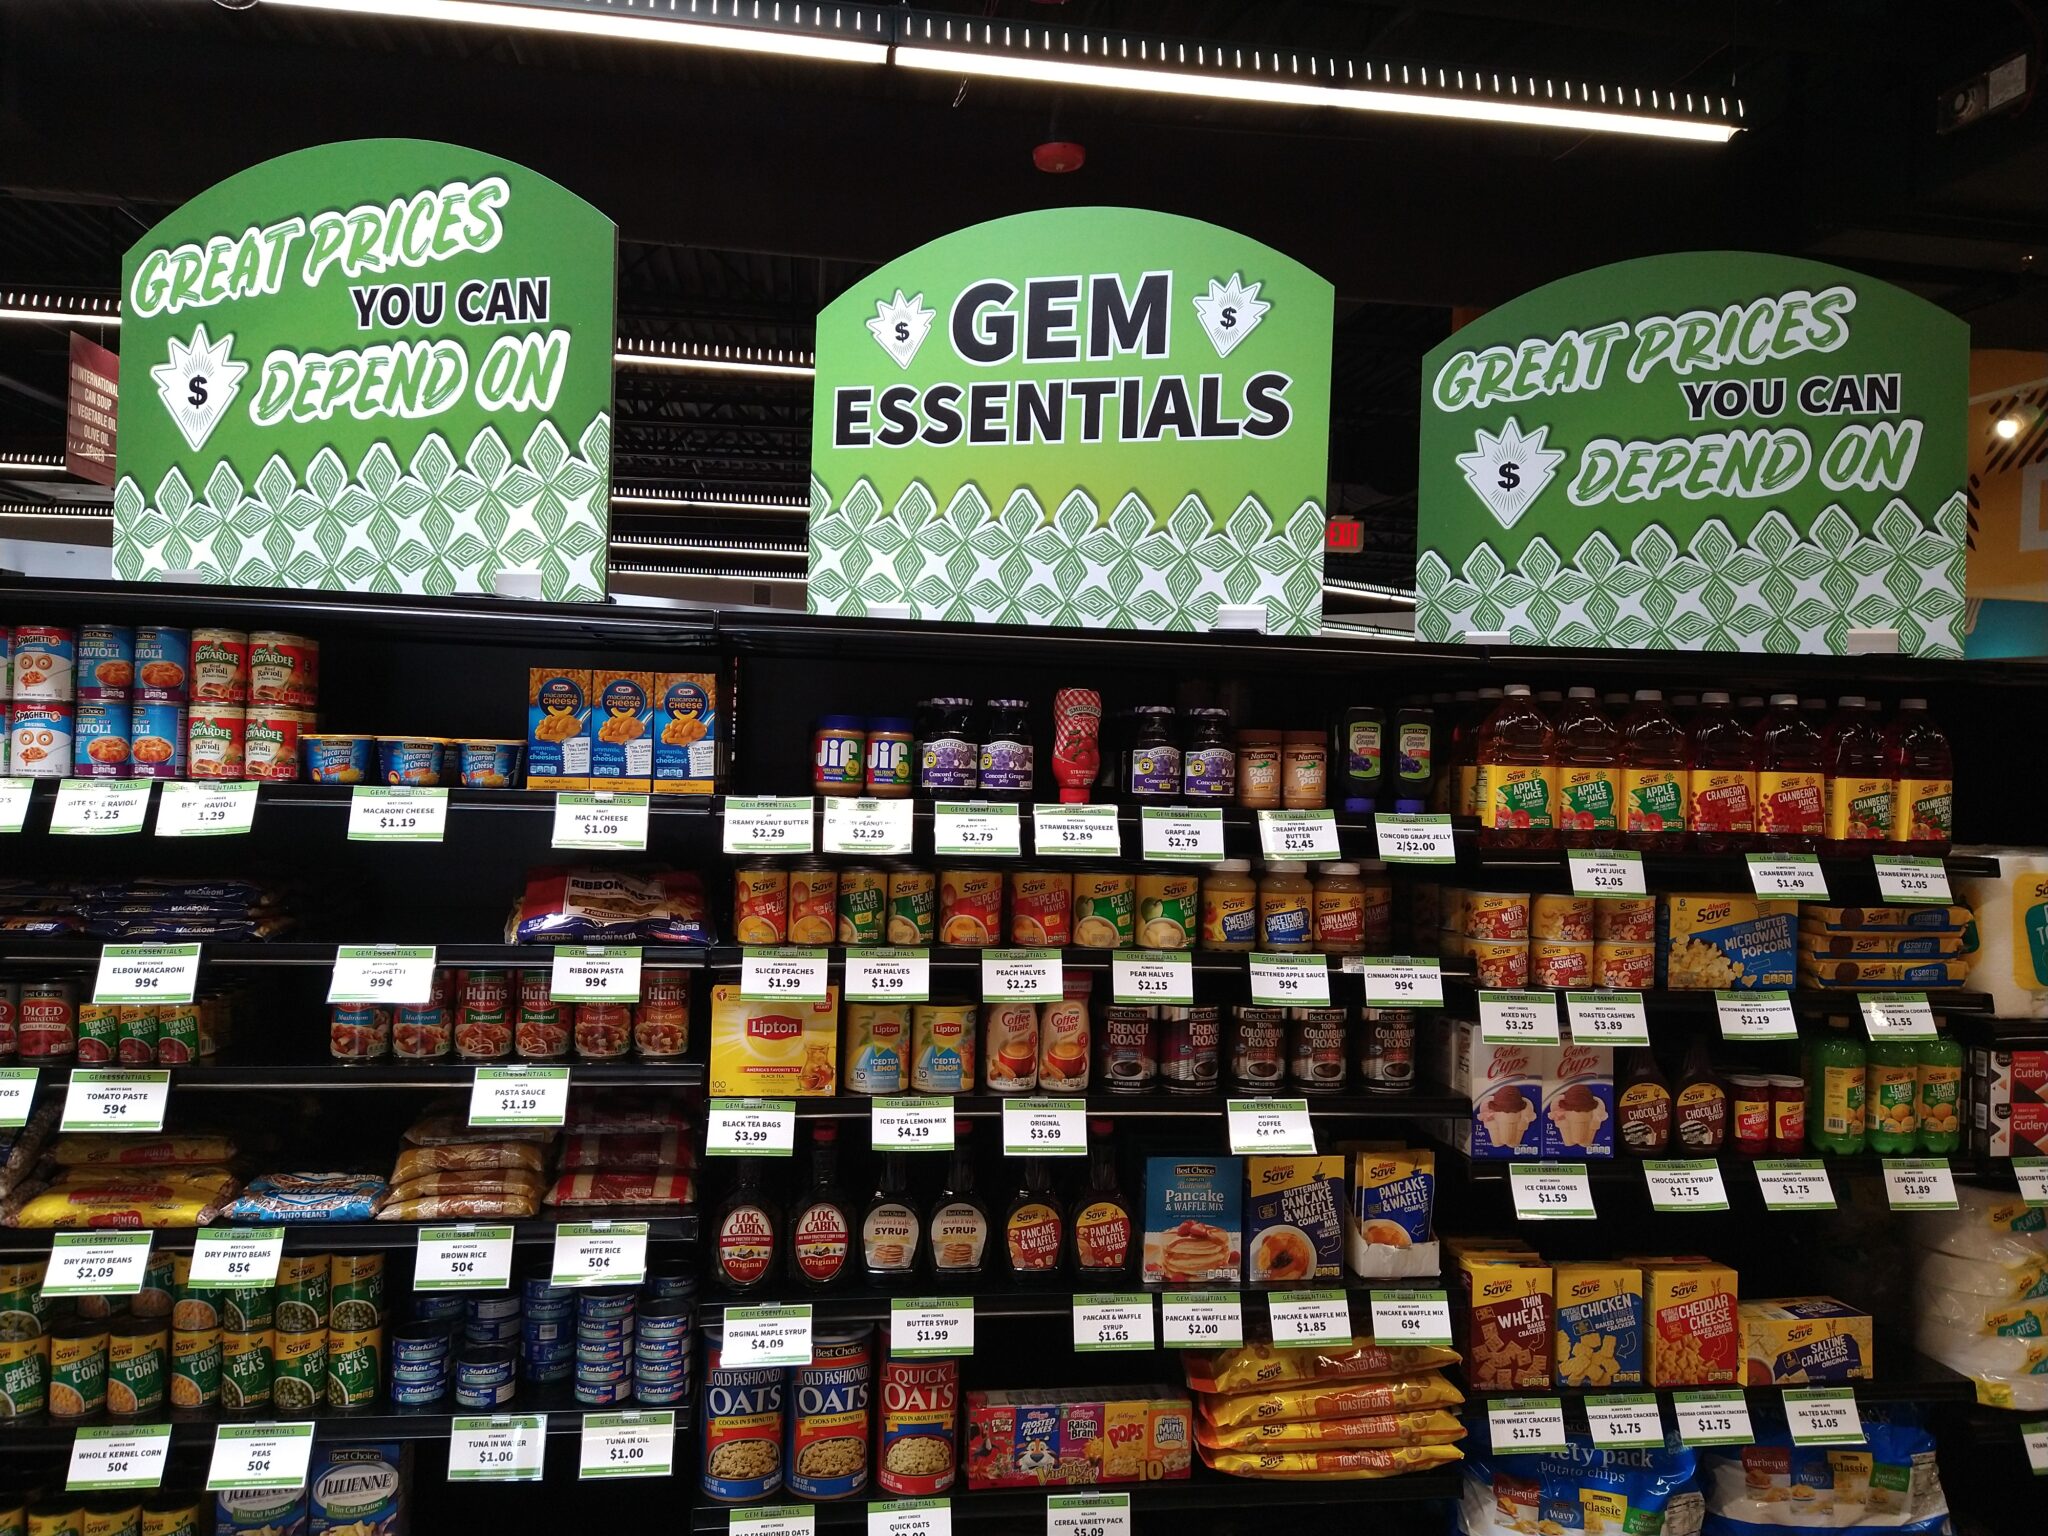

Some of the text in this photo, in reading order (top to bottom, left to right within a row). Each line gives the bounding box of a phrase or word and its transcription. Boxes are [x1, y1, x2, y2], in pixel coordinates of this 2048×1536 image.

[133, 180, 505, 317] GREAT PRICES
[351, 278, 548, 327] YOU CAN
[951, 272, 1171, 363] GEM
[1436, 289, 1853, 409] GREAT PRICES
[77, 367, 118, 397] INTERNATIONAL
[254, 334, 566, 424] DEPEND ON
[187, 375, 208, 409] $
[1681, 376, 1901, 419] YOU CAN
[84, 388, 112, 411] CAN SOUP
[834, 373, 1291, 447] ESSENTIALS
[78, 403, 116, 431] VEGETABLE OIL
[84, 425, 109, 446] OLIVE OIL
[1572, 424, 1920, 505] DEPEND ON
[1498, 461, 1520, 491] $
[1329, 520, 1360, 546] EXIT
[818, 740, 857, 767] Jif
[868, 742, 907, 768] Jif
[363, 807, 406, 815] MACARONI
[380, 817, 416, 828] $1.19
[584, 824, 618, 835] $1.09
[752, 828, 785, 838] $2.29
[853, 829, 884, 839] $2.29
[962, 832, 993, 842] $2.79
[1062, 832, 1093, 841] $2.89
[1168, 838, 1198, 847] $2.79
[1285, 839, 1314, 849] $2.45
[1397, 841, 1435, 852] 2/$2.00
[1594, 877, 1623, 887] $2.05
[1777, 878, 1805, 889] $1.49
[1900, 879, 1928, 890] $2.05
[1754, 916, 1787, 930] BUTTER
[1724, 927, 1790, 950] MICROWAVE
[1742, 939, 1792, 958] POPCORN
[135, 977, 159, 988] 99¢
[370, 978, 393, 987] 99¢
[585, 977, 607, 987] 99¢
[768, 978, 800, 989] $1.99
[872, 978, 903, 989] $1.99
[1007, 979, 1038, 990] $2.25
[1138, 980, 1168, 991] $2.15
[1279, 980, 1298, 990] 99¢
[1395, 981, 1414, 991] 99¢
[1741, 1015, 1770, 1025] $2.19
[752, 1022, 798, 1035] Lipton
[875, 1025, 899, 1034] Lipton
[936, 1025, 960, 1034] Lipton
[1506, 1021, 1534, 1031] $3.25
[1594, 1021, 1622, 1031] $3.89
[103, 1104, 127, 1115] 59¢
[501, 1099, 536, 1110] $1.19
[735, 1130, 767, 1141] $3.99
[897, 1127, 929, 1137] $4.19
[1030, 1129, 1061, 1139] $3.69
[1176, 1166, 1215, 1175] Best Choice
[1670, 1186, 1699, 1197] $1.75
[1783, 1185, 1809, 1195] $1.75
[1904, 1185, 1930, 1195] $1.89
[1165, 1190, 1224, 1203] Pancake
[1538, 1193, 1567, 1203] $1.59
[735, 1212, 759, 1225] LOG
[729, 1223, 765, 1235] CABIN
[580, 1247, 603, 1255] WHITE
[228, 1262, 251, 1273] 85¢
[451, 1261, 474, 1273] 50¢
[588, 1257, 610, 1268] 50¢
[729, 1260, 762, 1269] Original
[77, 1267, 114, 1278] $2.09
[935, 1319, 959, 1327] SYRUP
[1401, 1318, 1420, 1329] 69¢
[1498, 1309, 1544, 1329] WHEAT
[1188, 1324, 1218, 1335] $2.00
[1297, 1322, 1326, 1333] $1.85
[917, 1330, 948, 1341] $1.99
[1098, 1330, 1128, 1342] $1.65
[751, 1339, 784, 1350] $4.09
[1810, 1335, 1845, 1354] SALTINE
[1801, 1345, 1848, 1368] CRACKERS
[895, 1369, 946, 1384] QUICK
[709, 1385, 782, 1414] OATS
[799, 1383, 868, 1414] OATS
[884, 1383, 953, 1411] OATS
[1609, 1423, 1641, 1434] $1.75
[1698, 1419, 1731, 1431] $1.75
[1812, 1418, 1838, 1429] $1.05
[1513, 1428, 1541, 1439] $1.75
[78, 1451, 107, 1459] WHOLE
[479, 1451, 513, 1463] $1.00
[610, 1448, 643, 1460] $1.00
[107, 1462, 128, 1472] 50¢
[248, 1461, 270, 1472] 50¢
[1585, 1501, 1621, 1516] Classic
[1549, 1510, 1574, 1522] Wavy
